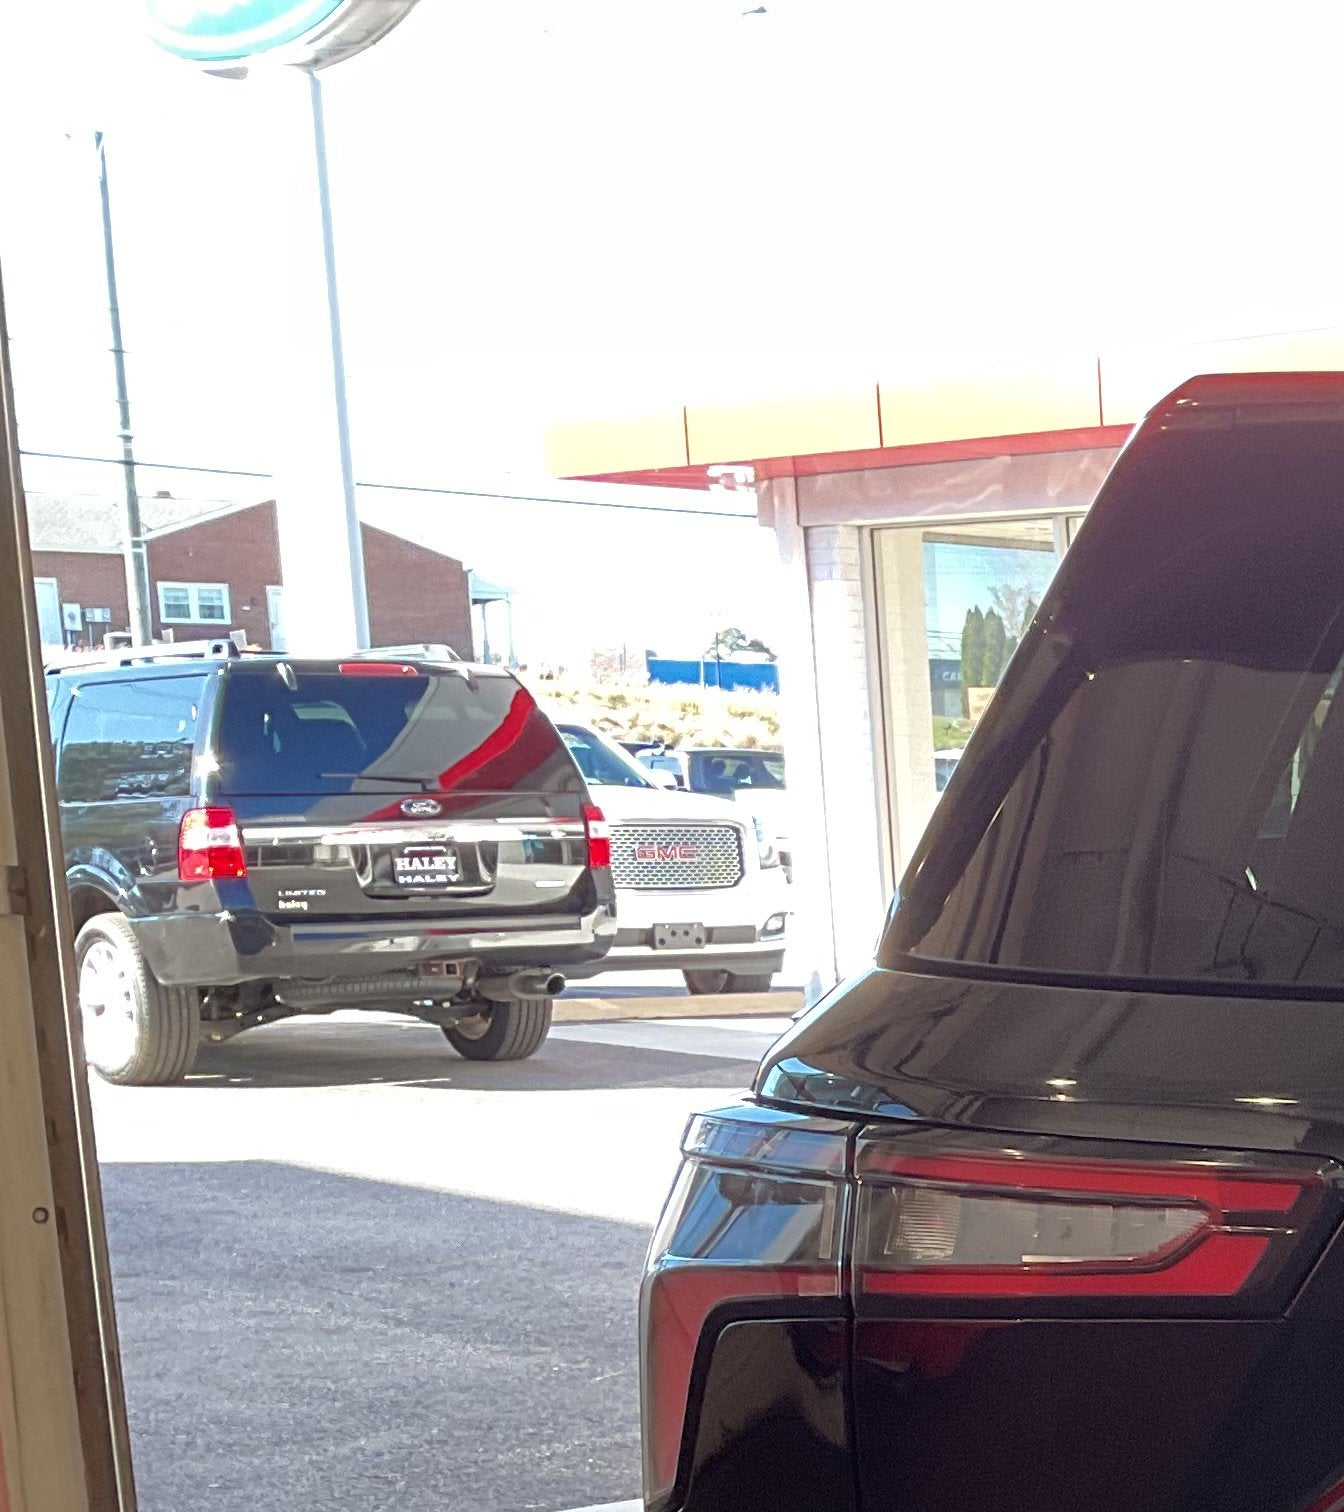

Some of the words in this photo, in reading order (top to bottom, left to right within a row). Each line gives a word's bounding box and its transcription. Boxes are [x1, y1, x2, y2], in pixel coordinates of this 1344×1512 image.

[635, 845, 698, 861] GMC
[395, 856, 457, 870] HALEY
[399, 874, 460, 883] HALEY
